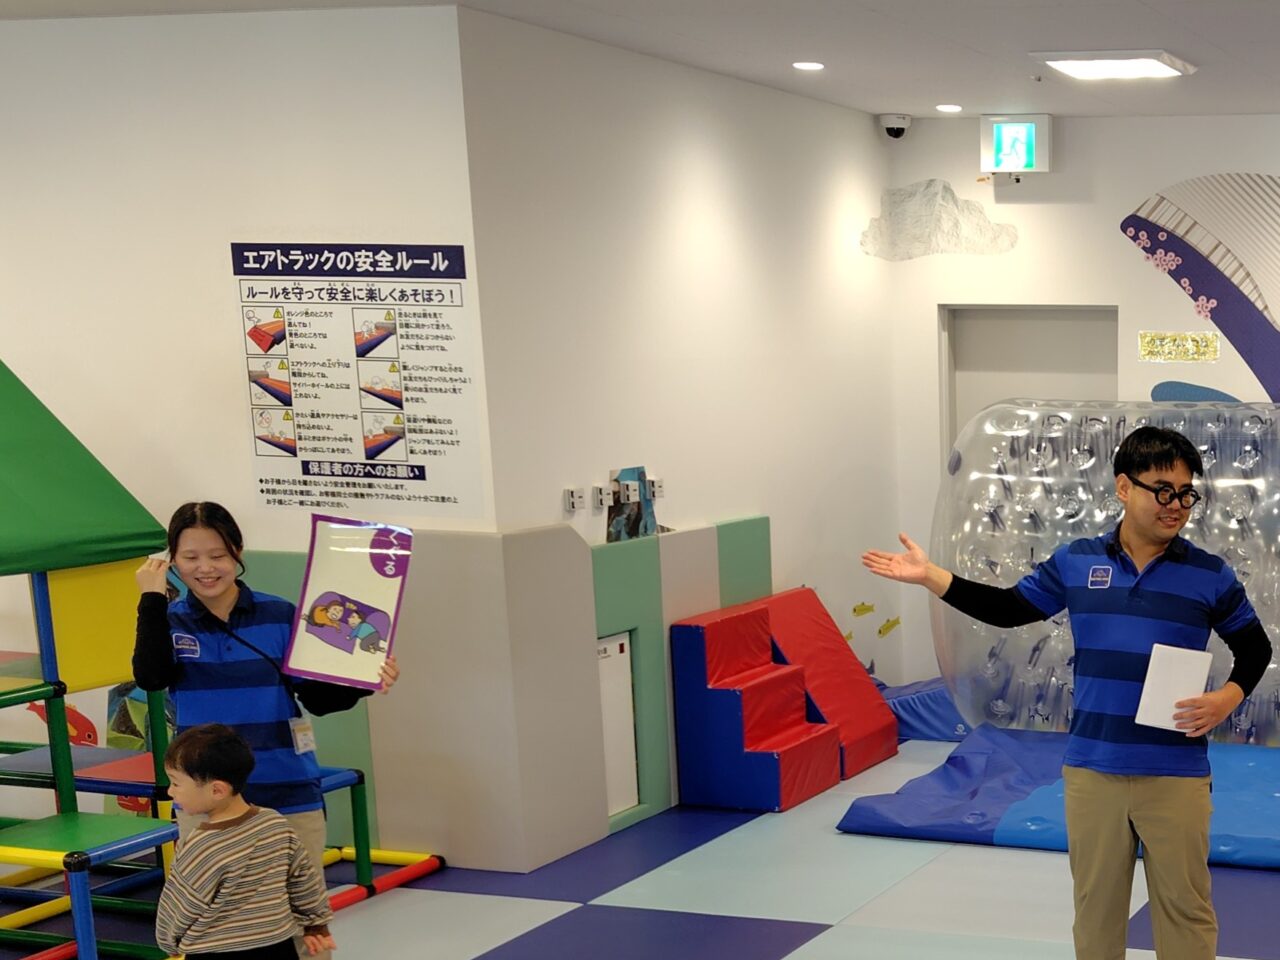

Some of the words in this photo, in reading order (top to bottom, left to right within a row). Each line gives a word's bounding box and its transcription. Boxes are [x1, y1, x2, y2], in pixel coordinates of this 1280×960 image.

[243, 249, 449, 273] エアトラックの安全ルール
[308, 463, 420, 478] 保護者の方へのお願い
